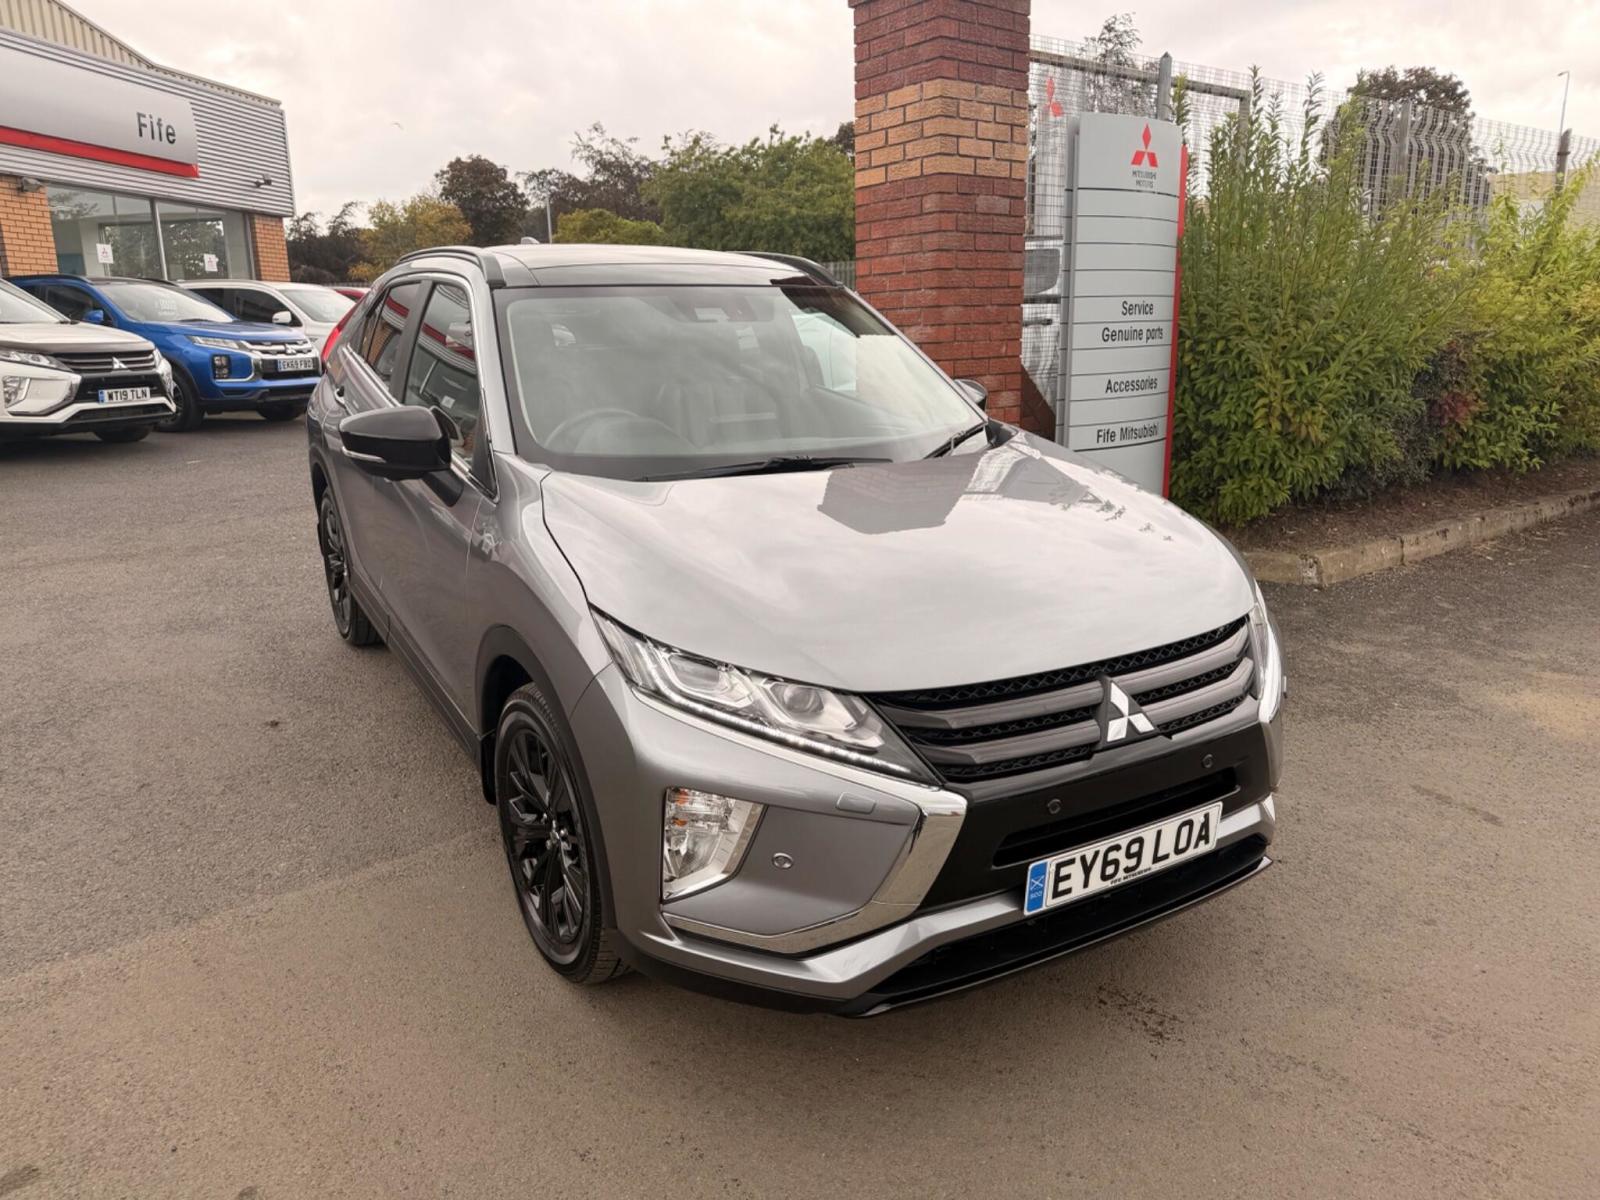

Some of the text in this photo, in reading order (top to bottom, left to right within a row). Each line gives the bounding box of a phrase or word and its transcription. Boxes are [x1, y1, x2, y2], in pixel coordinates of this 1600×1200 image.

[136, 111, 176, 144] Fife
[1121, 300, 1154, 316] Service
[1101, 326, 1163, 344] Genuine parts
[130, 388, 148, 399] TLN
[1105, 377, 1158, 394] Accessories
[1096, 421, 1159, 443] Fife Mitsubishi
[1051, 812, 1210, 900] EY69 LOA
